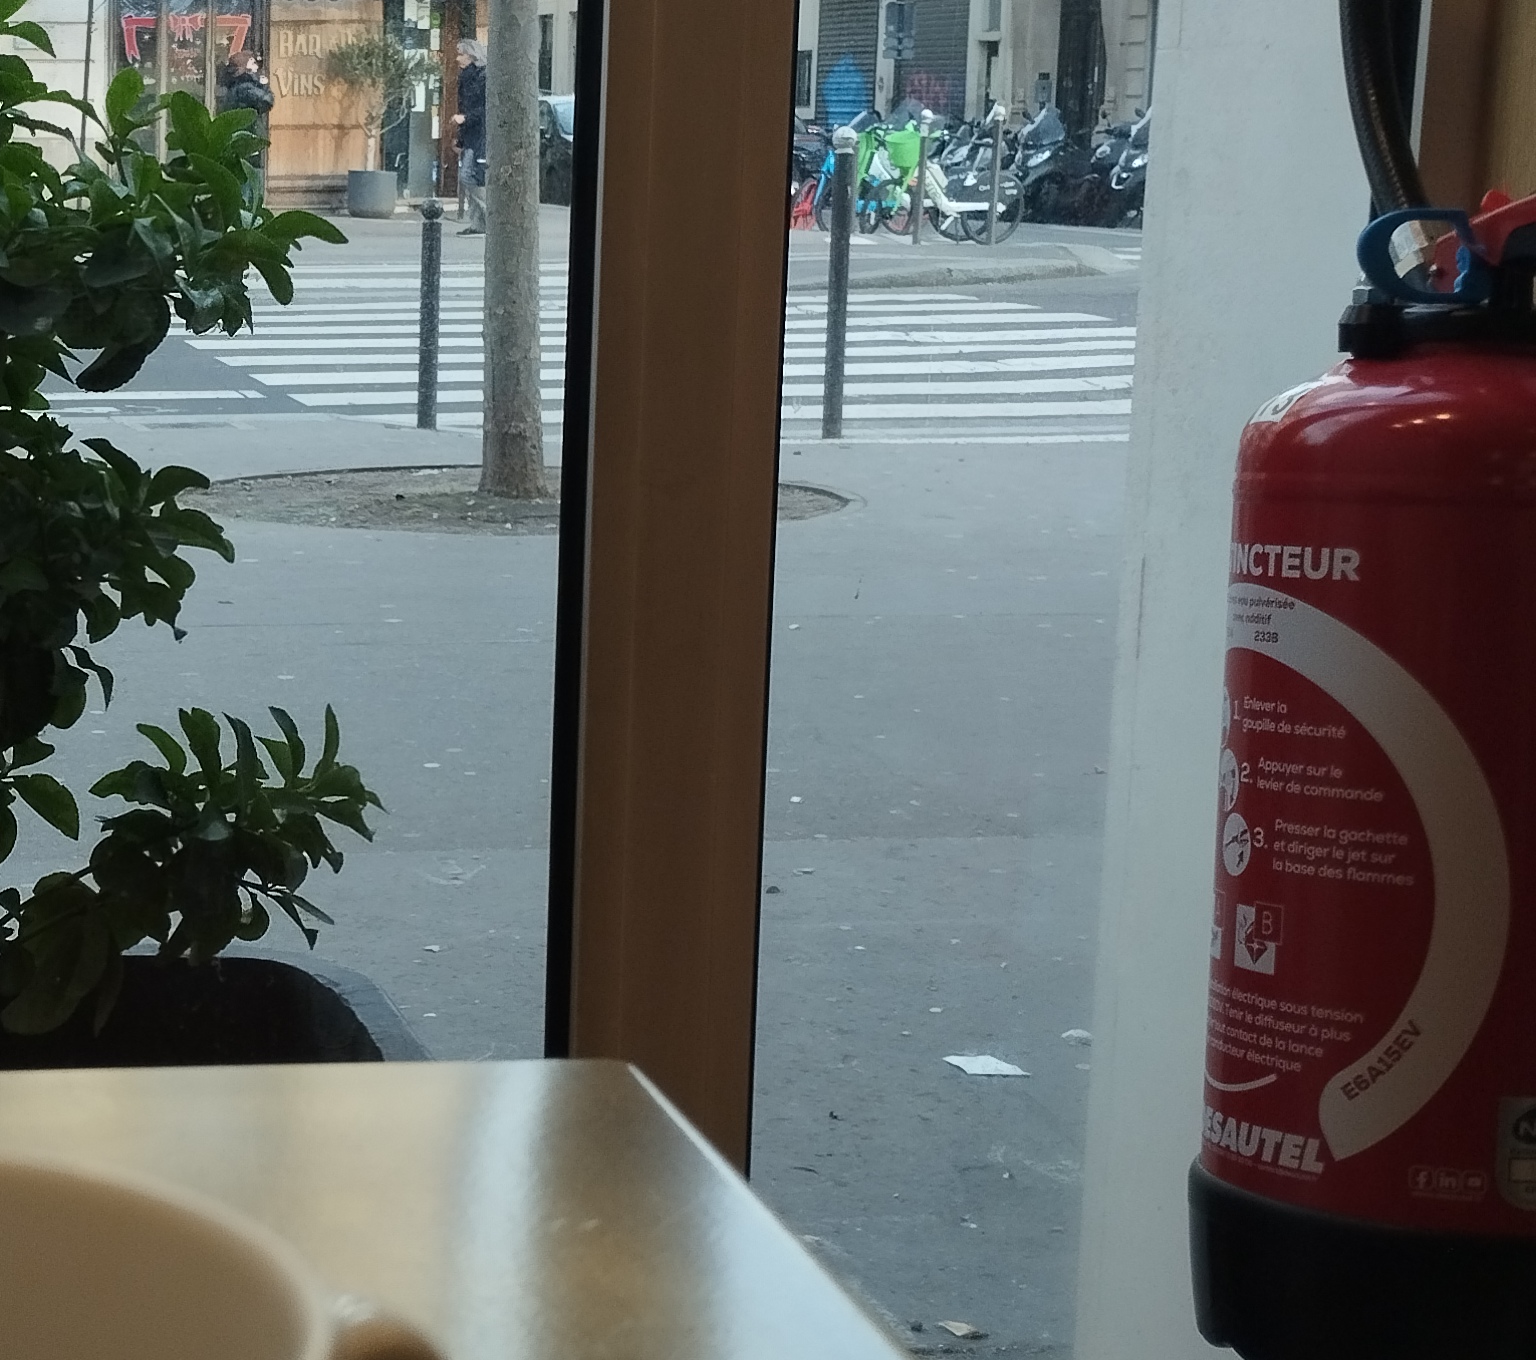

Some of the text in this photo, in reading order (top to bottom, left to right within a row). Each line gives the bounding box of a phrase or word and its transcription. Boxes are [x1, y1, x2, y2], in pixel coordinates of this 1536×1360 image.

[1229, 542, 1360, 581] INCTEUR
[1243, 696, 1287, 714] Enlever la
[1242, 718, 1346, 739] goupille de sécurité
[1258, 756, 1343, 779] Appuyer sur le
[1256, 776, 1384, 803] levier de commande
[1275, 818, 1321, 837] Presser
[1323, 825, 1336, 839] la
[1273, 840, 1396, 865] et diriger le jet sur
[1272, 857, 1415, 887] la base des flammes
[1261, 911, 1273, 935] B
[1279, 1001, 1308, 1015] sous
[1310, 1005, 1364, 1023] tension
[1254, 1013, 1306, 1035] diffuseur
[1308, 1024, 1318, 1037] à
[1320, 1027, 1352, 1042] plus
[1226, 1026, 1257, 1045] contact
[1259, 1033, 1273, 1048] de
[1274, 1036, 1286, 1051] la
[1288, 1040, 1323, 1058] lance
[1246, 1048, 1302, 1073] électrique
[1340, 1019, 1421, 1101] E6A15EV
[1203, 1105, 1325, 1175] ESAUTEL
